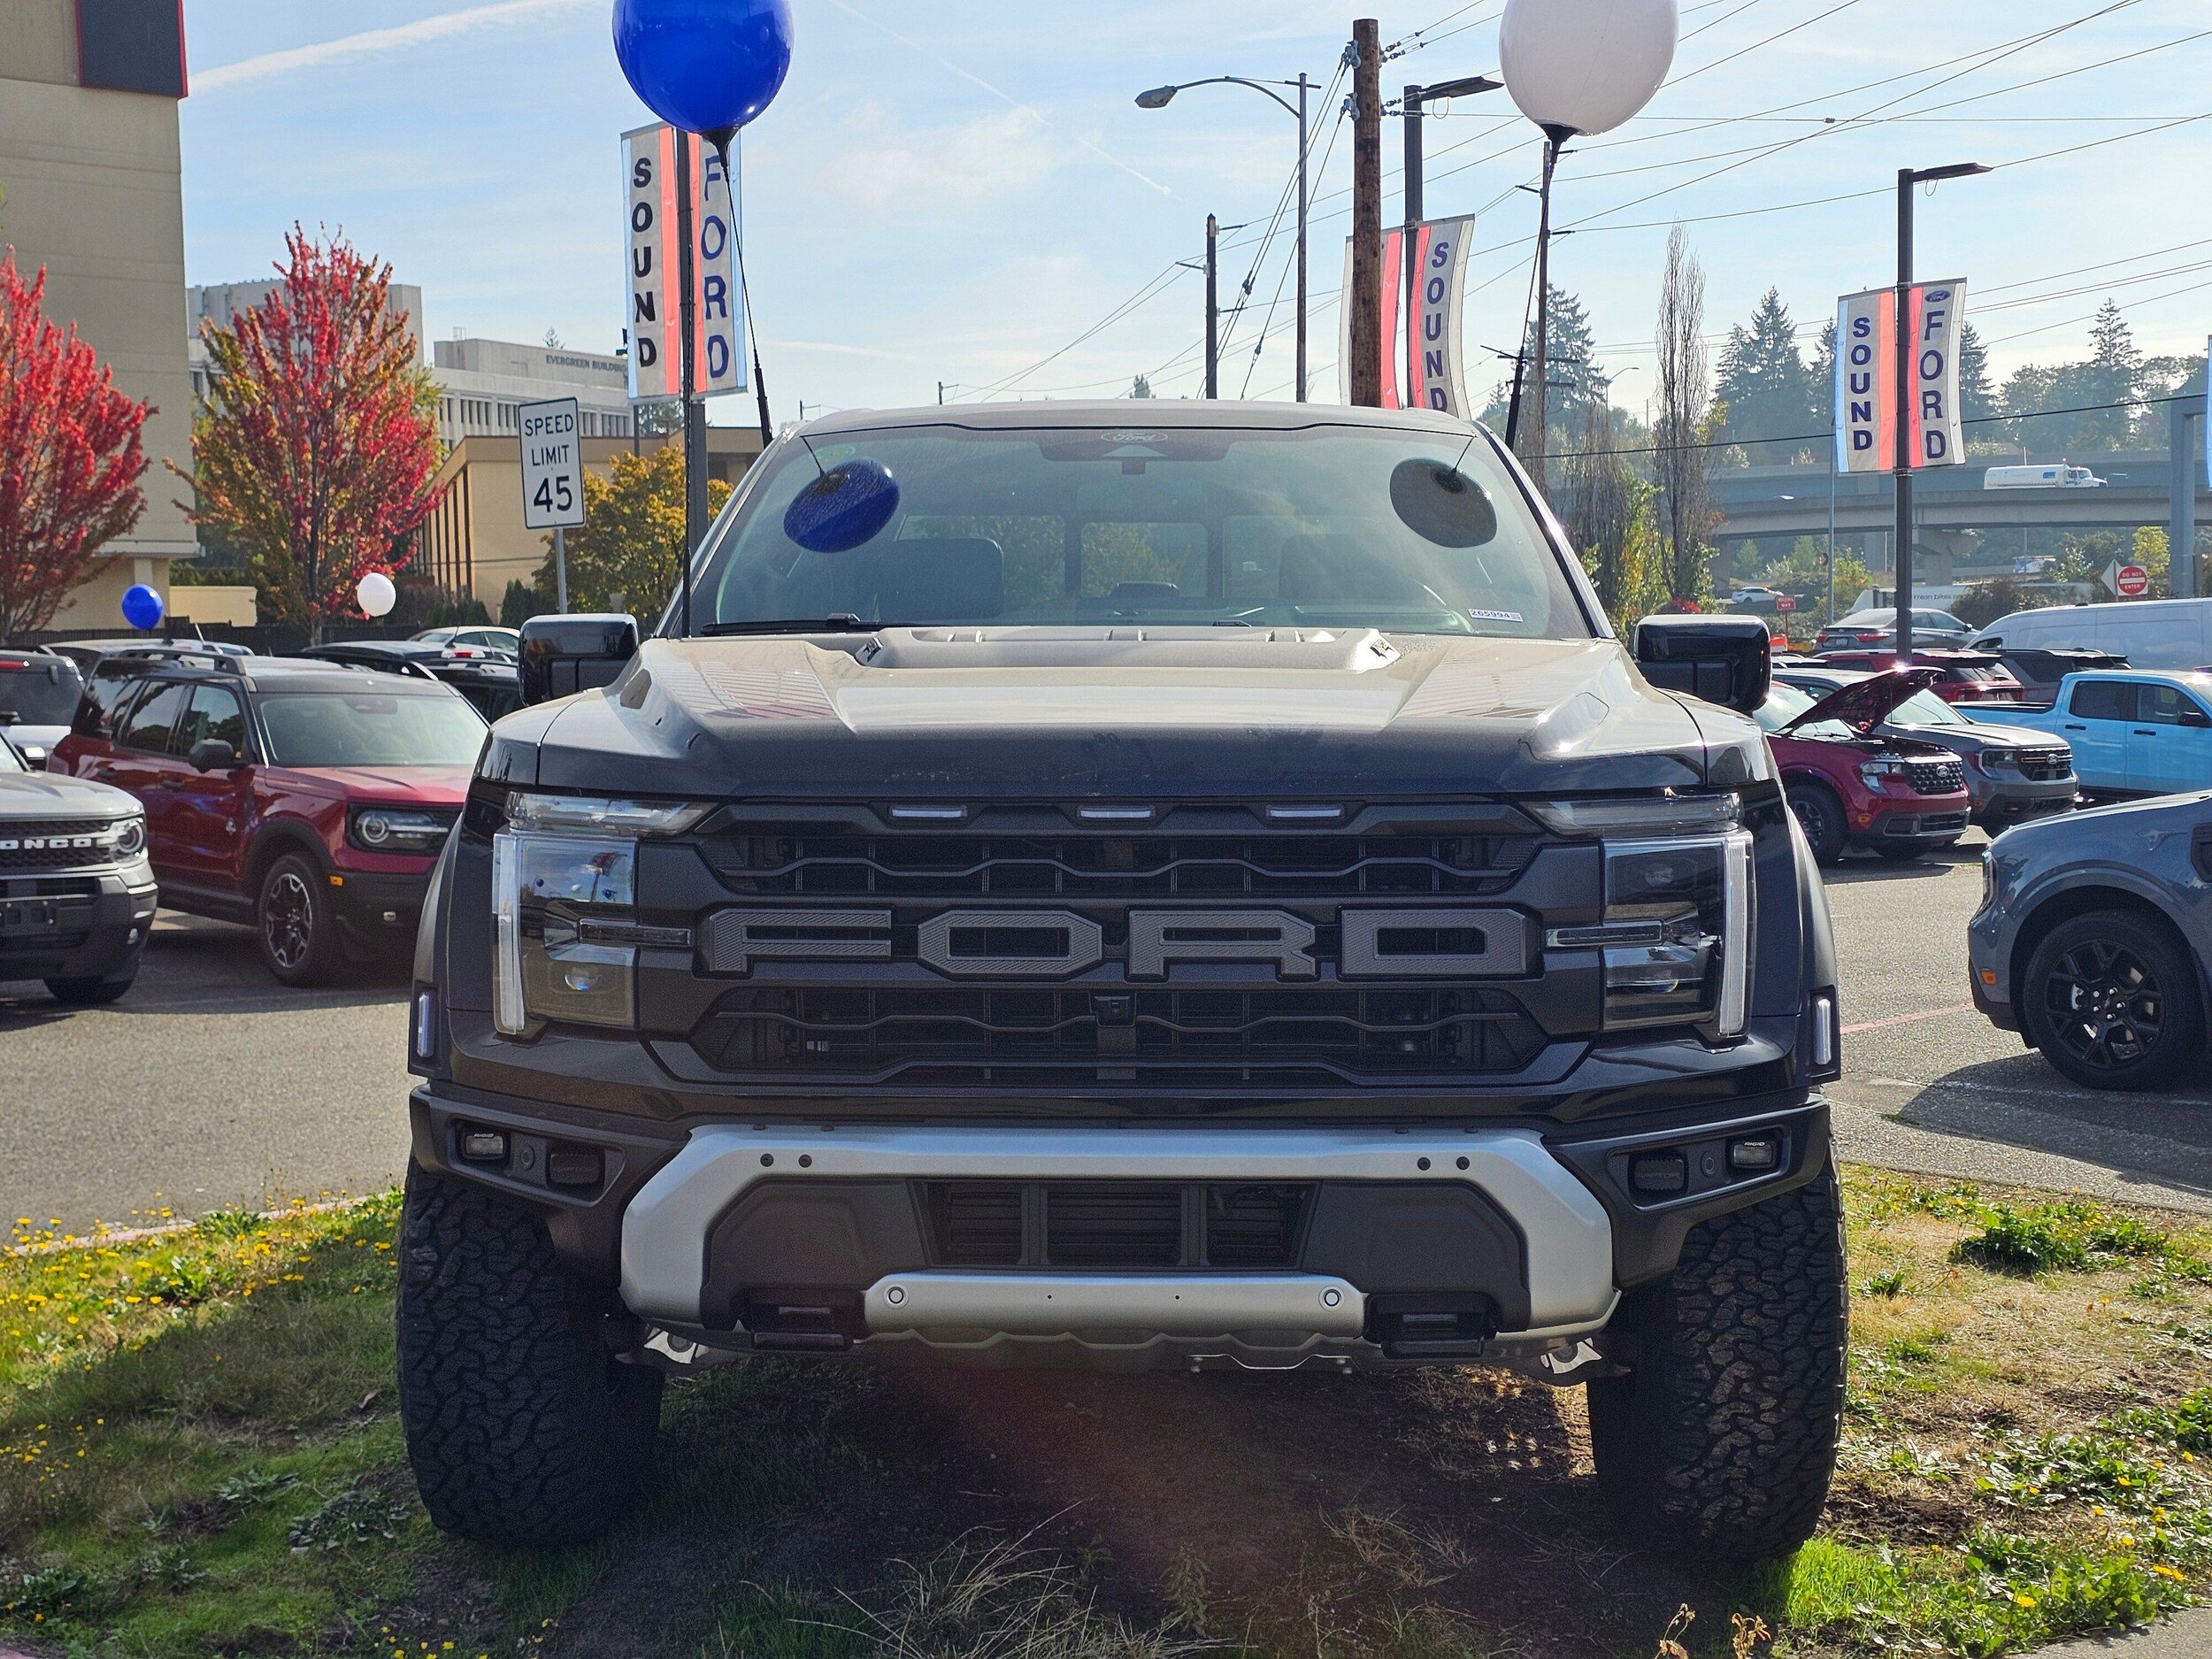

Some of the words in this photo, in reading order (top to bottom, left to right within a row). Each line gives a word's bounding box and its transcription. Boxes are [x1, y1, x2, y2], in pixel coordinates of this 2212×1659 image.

[631, 157, 657, 367] SOUND
[701, 154, 729, 379] FORD
[546, 354, 590, 368] EVERGREEN
[1425, 241, 1449, 411] SOUND
[525, 413, 573, 437] SPEED
[1850, 317, 1873, 450] SOUND
[1919, 311, 1946, 458] FORD
[532, 444, 569, 466] LIMIT
[534, 475, 572, 513] 45
[709, 909, 1526, 976] FORD
